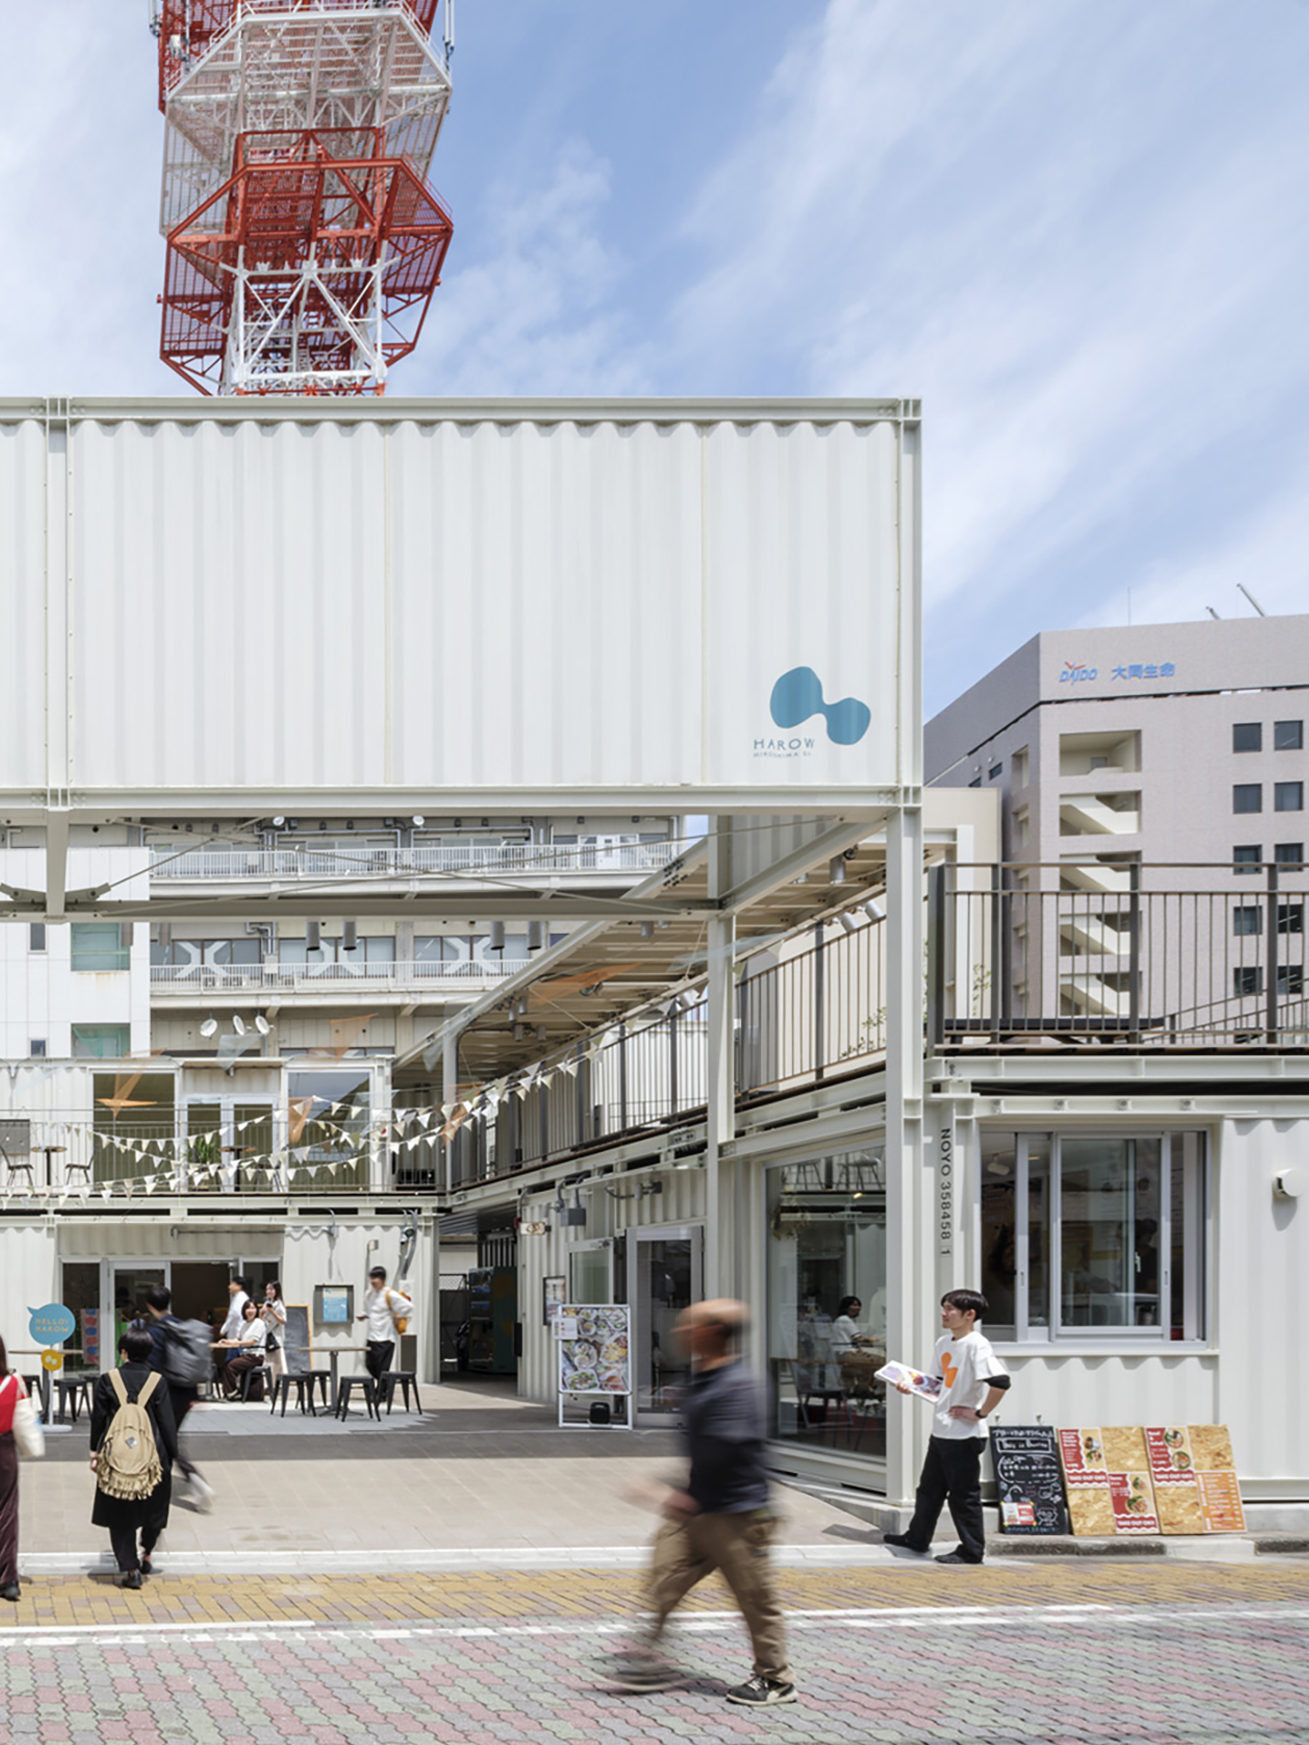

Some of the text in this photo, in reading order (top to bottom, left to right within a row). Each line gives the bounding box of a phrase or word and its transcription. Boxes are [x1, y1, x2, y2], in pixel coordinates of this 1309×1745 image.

[1111, 662, 1175, 680] 大同生命
[753, 737, 815, 751] HAROW
[940, 1127, 952, 1177] NOYO
[940, 1181, 952, 1240] 358458
[35, 1318, 70, 1326] HELLO!
